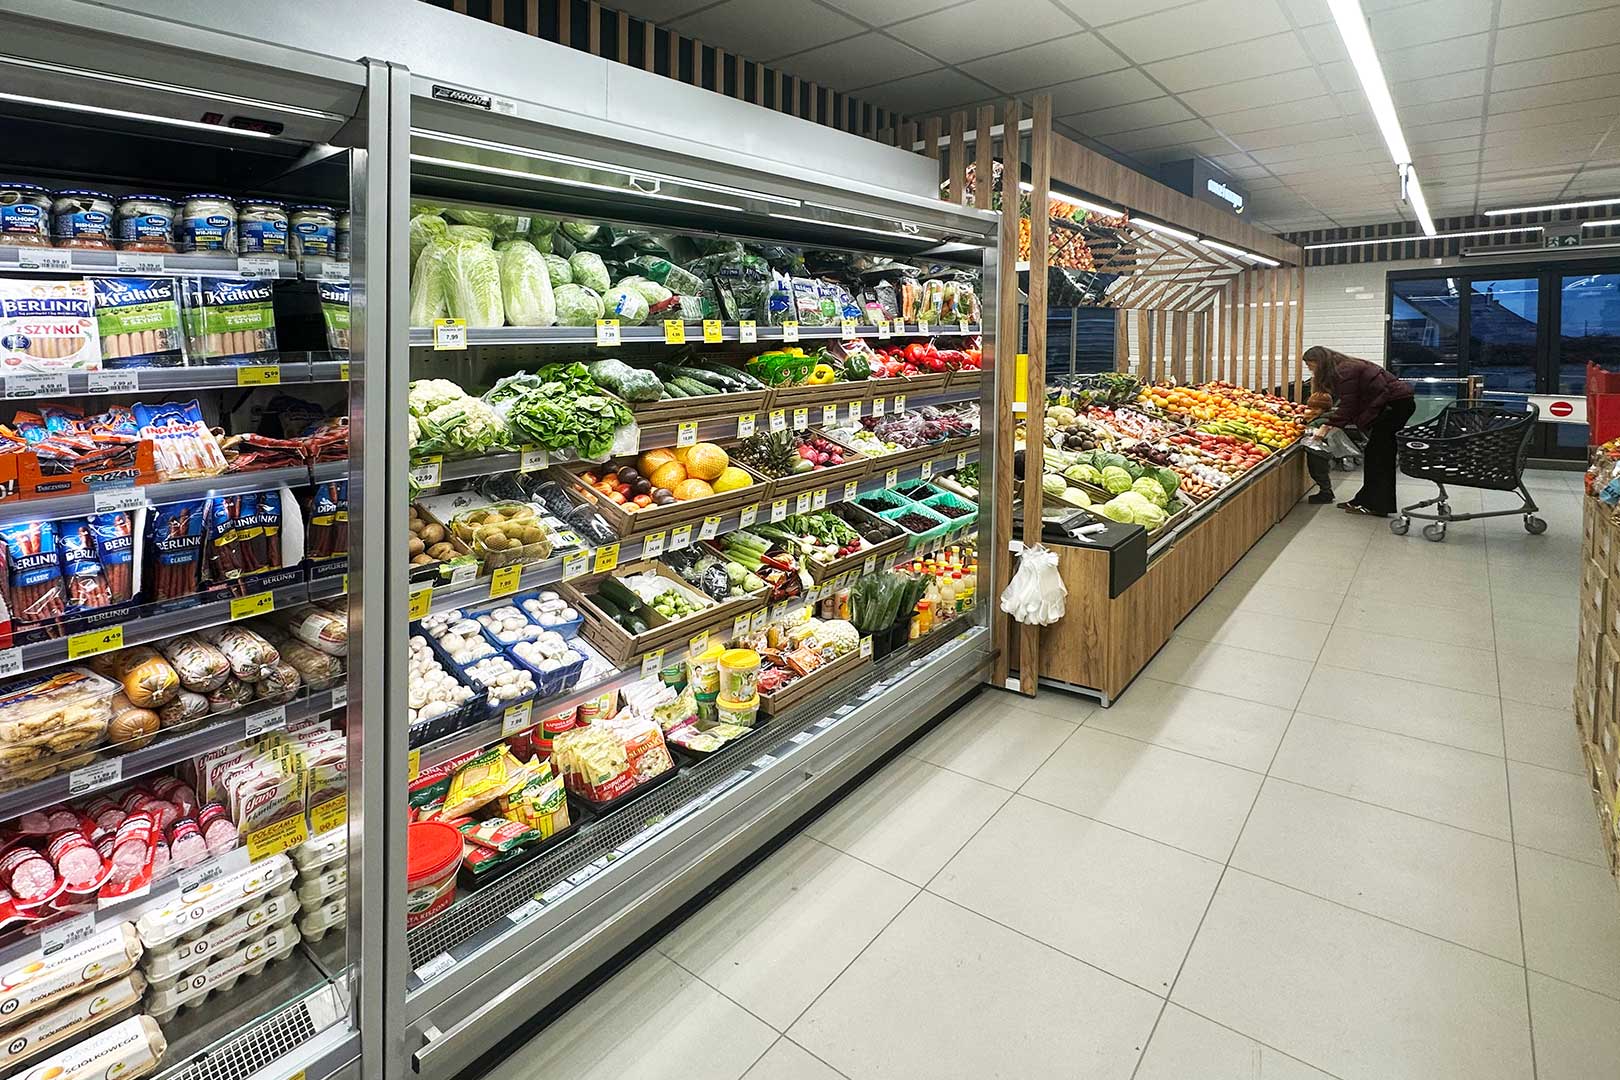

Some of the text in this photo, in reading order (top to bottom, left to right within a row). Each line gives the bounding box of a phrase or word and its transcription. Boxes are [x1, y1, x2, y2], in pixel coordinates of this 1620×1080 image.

[209, 217, 229, 225] Lisner
[96, 286, 171, 307] Krakus
[205, 286, 269, 304] Krakus
[6, 300, 88, 313] BERLINKI
[23, 325, 80, 335] SZYNKI
[263, 574, 296, 586] BERLINKI
[88, 608, 129, 623] BERLINKI
